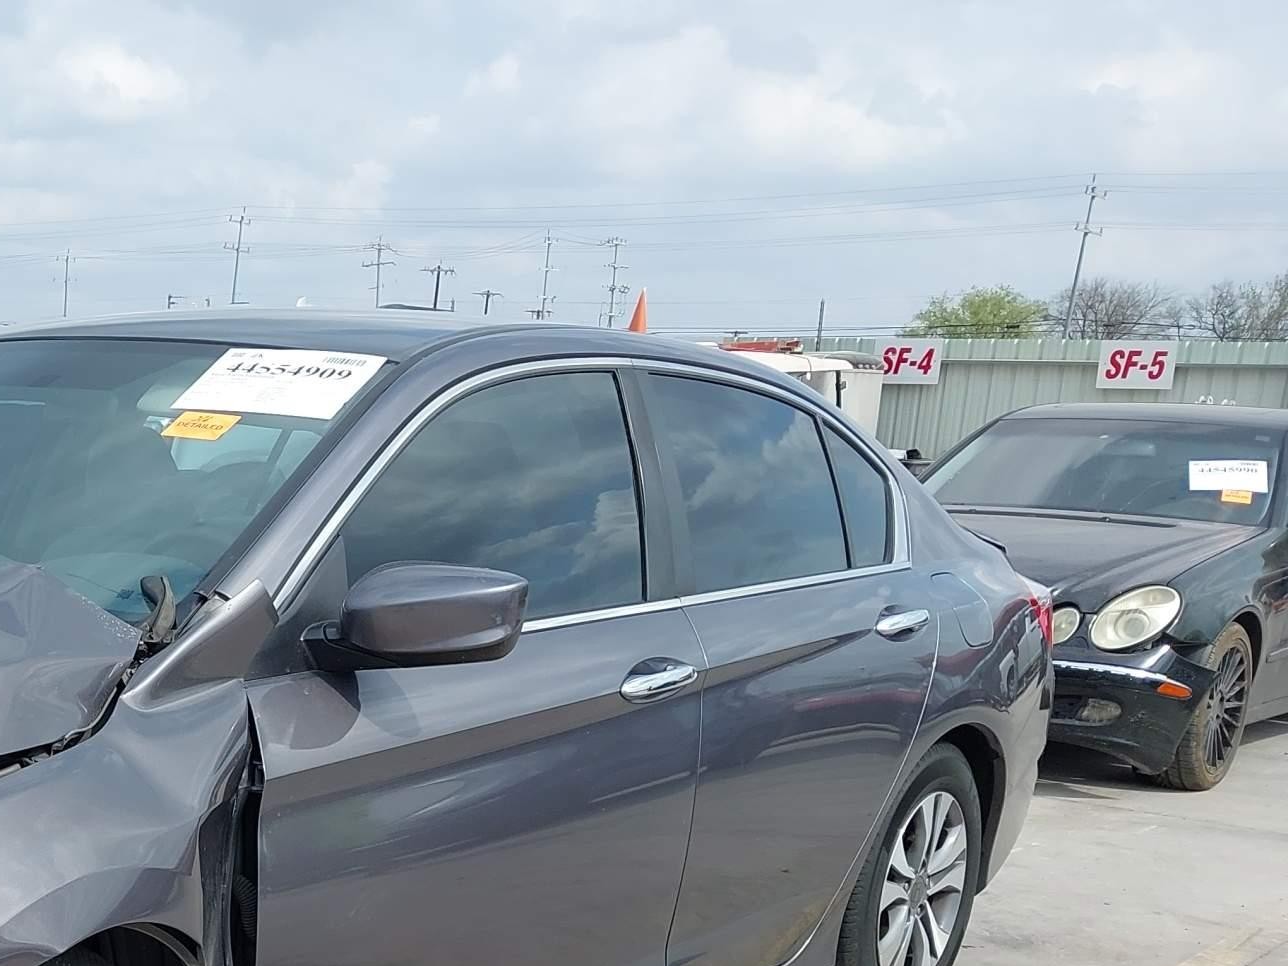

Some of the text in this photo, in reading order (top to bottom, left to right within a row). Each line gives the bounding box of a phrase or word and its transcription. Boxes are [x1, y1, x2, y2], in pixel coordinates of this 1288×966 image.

[226, 361, 353, 381] 44554909
[882, 346, 936, 376] SF-4
[1104, 349, 1169, 380] SF-5
